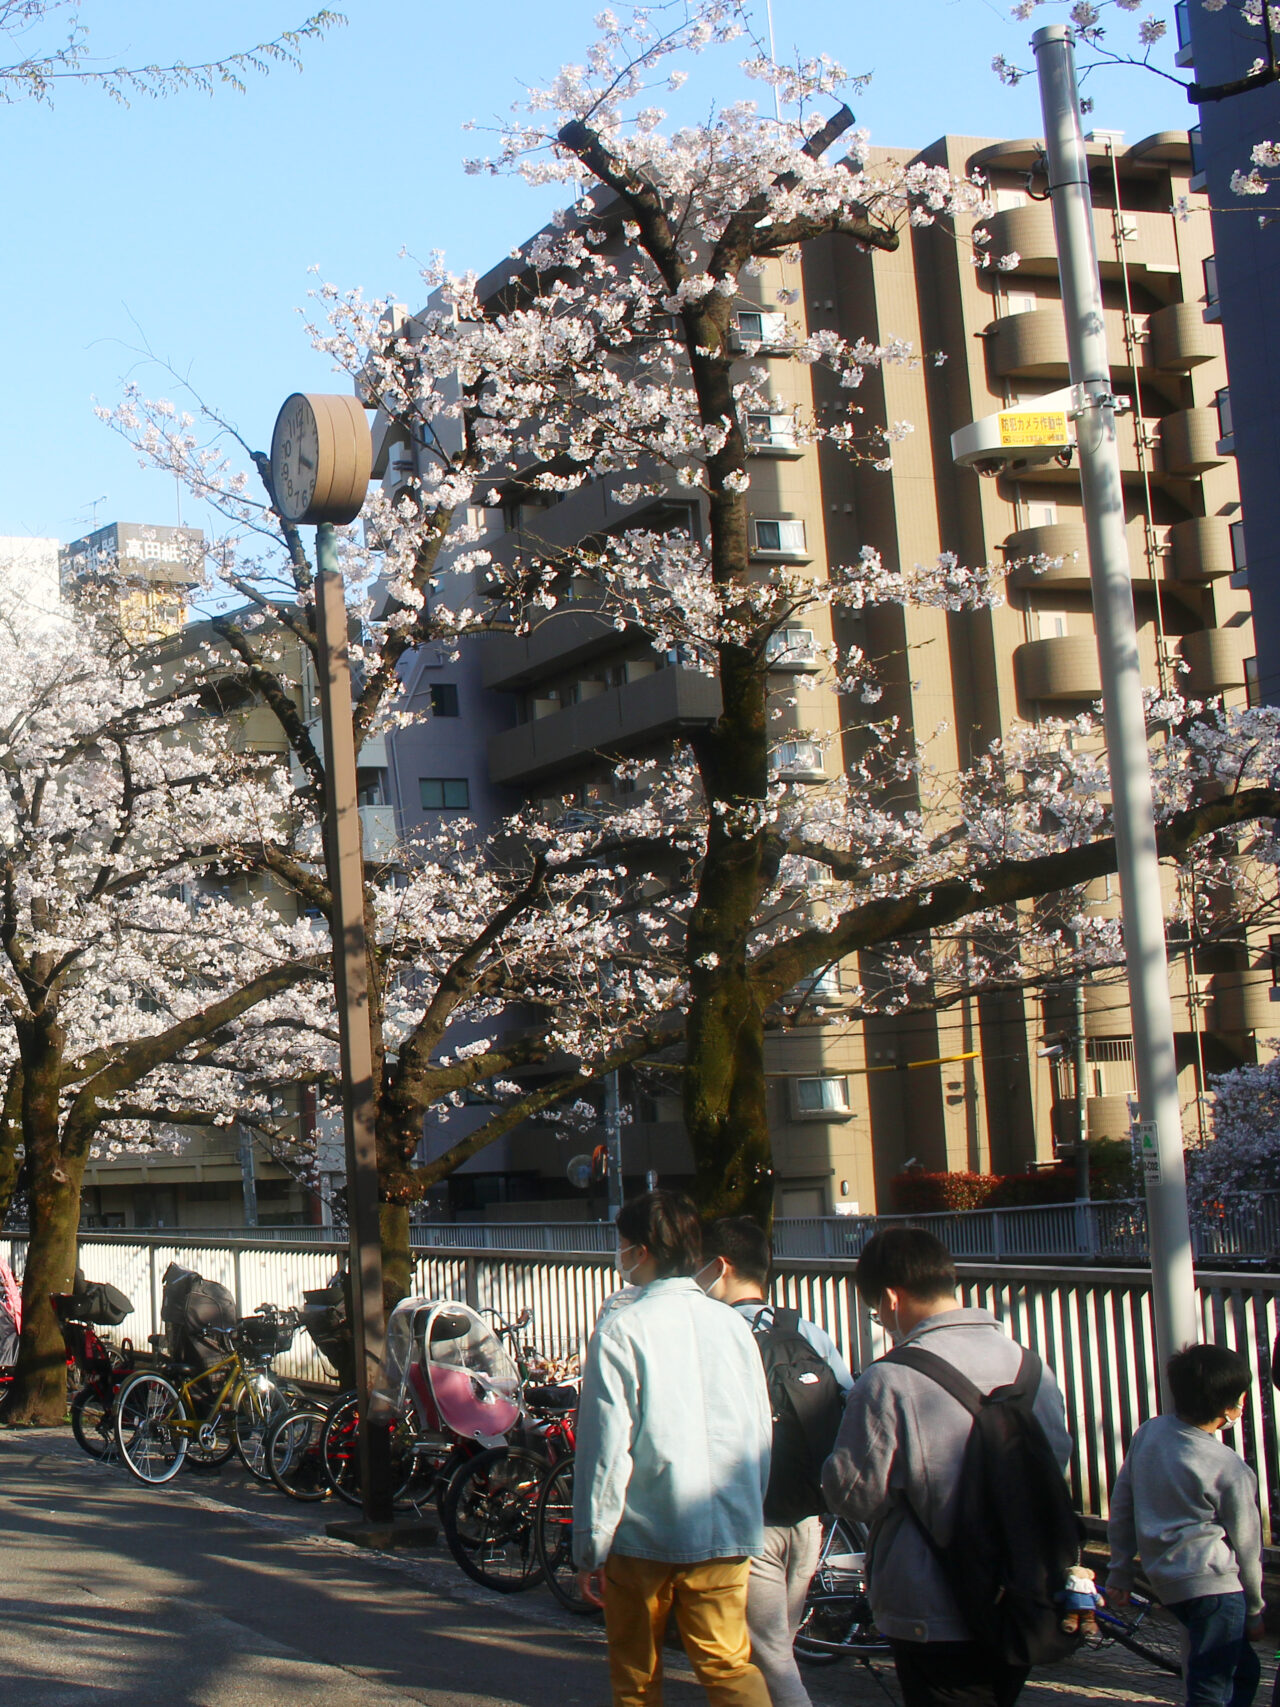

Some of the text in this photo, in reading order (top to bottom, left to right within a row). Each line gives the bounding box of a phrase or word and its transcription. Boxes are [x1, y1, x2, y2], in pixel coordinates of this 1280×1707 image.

[296, 407, 304, 428] 12
[1001, 415, 1063, 432] 防犯カメラ作動中
[288, 419, 295, 438] 11
[284, 440, 292, 459] 10
[283, 463, 289, 480] 9
[287, 479, 293, 497] 8
[294, 491, 300, 508] 7
[302, 490, 308, 508] 6
[126, 538, 198, 563] 高田紙
